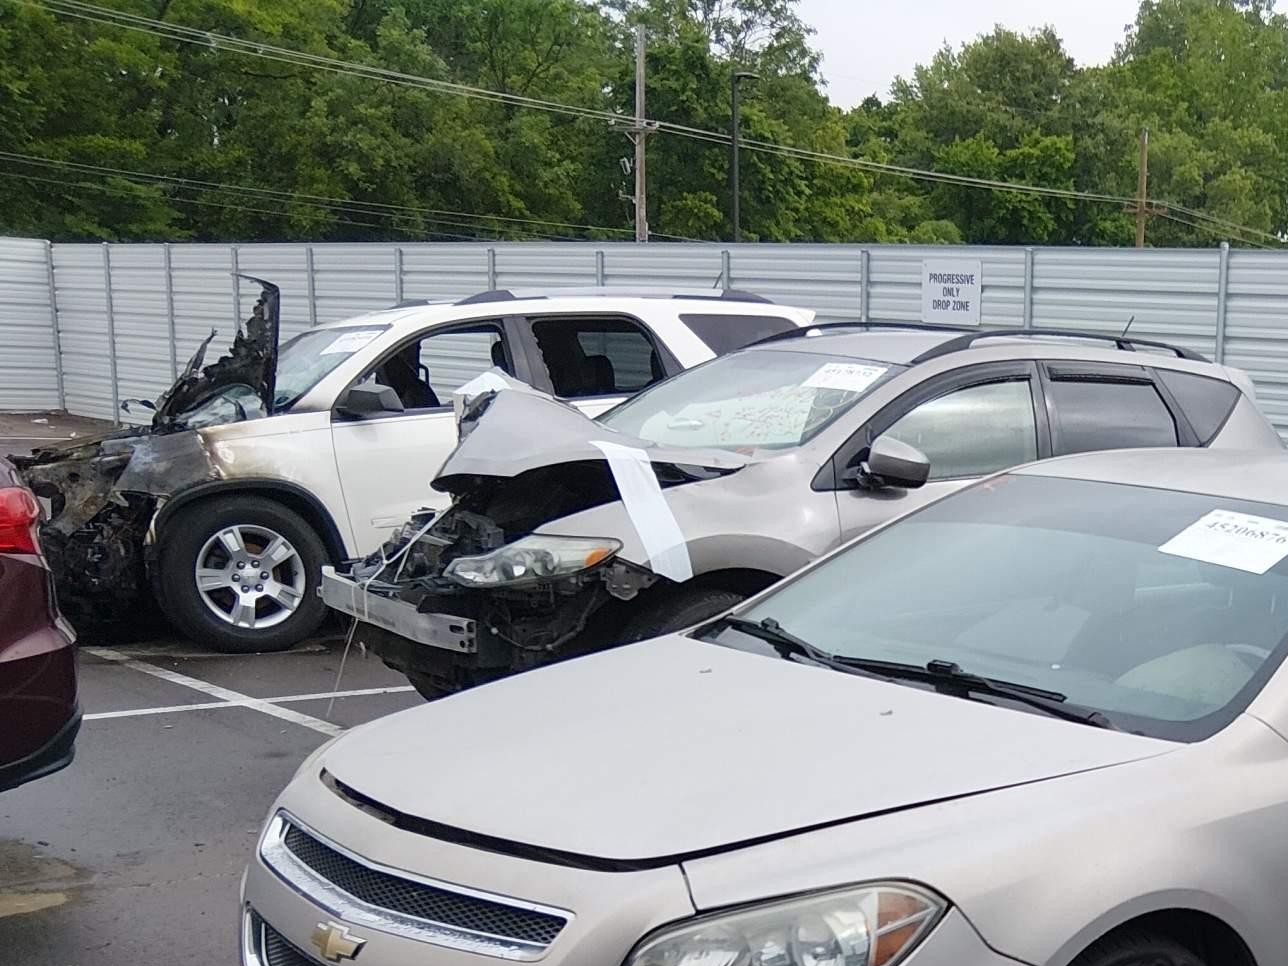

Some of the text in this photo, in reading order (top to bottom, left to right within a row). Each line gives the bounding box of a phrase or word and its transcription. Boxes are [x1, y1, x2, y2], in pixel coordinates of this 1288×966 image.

[929, 273, 975, 285] PROGRESSIVE
[942, 287, 960, 297] ONLY
[932, 299, 970, 311] DROP ZONE
